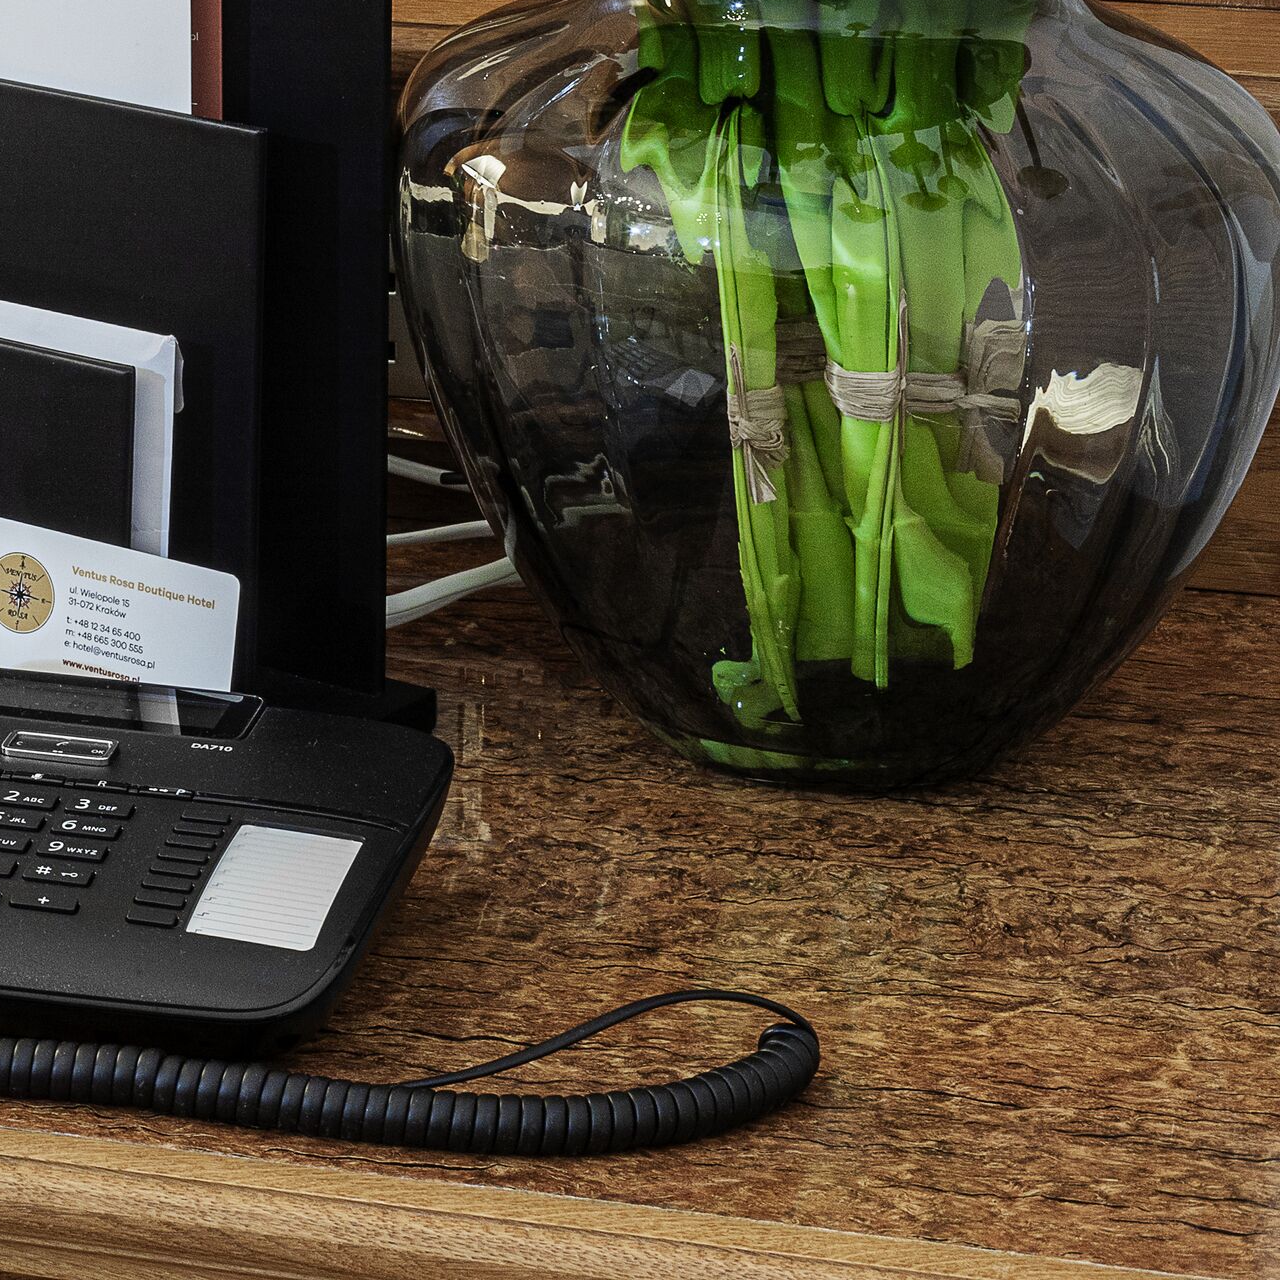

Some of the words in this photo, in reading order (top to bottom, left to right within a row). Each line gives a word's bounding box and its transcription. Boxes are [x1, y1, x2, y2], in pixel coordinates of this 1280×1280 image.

[72, 565, 107, 583] Ventus
[109, 575, 135, 590] Rosa
[137, 582, 185, 601] Boutique
[187, 595, 215, 609] Hotel
[69, 586, 78, 595] ul.
[80, 588, 120, 606] Wielopole
[122, 598, 130, 608] 15
[68, 597, 94, 611] 31-072
[96, 604, 126, 619] Kraków
[66, 616, 72, 624] t:
[74, 618, 89, 629] +48
[91, 622, 99, 631] 12
[100, 624, 110, 633] 34
[112, 627, 122, 637] 65
[124, 631, 141, 642] 400
[65, 629, 75, 637] m:
[77, 631, 92, 641] +48
[94, 635, 109, 646] 665
[110, 639, 127, 650] 300
[128, 643, 144, 654] 555
[64, 640, 71, 648] e:
[72, 641, 156, 669] hotel@ventusrosa.pl
[191, 742, 233, 752] DA710
[3, 790, 21, 802] 2
[22, 796, 45, 804] ABC
[176, 788, 186, 796] P
[74, 798, 91, 810] 3
[97, 804, 118, 812] DEF
[9, 816, 27, 825] JKL
[61, 820, 79, 830] 6
[81, 825, 107, 833] MNO
[48, 841, 65, 852] 9
[66, 847, 98, 856] WXYZ
